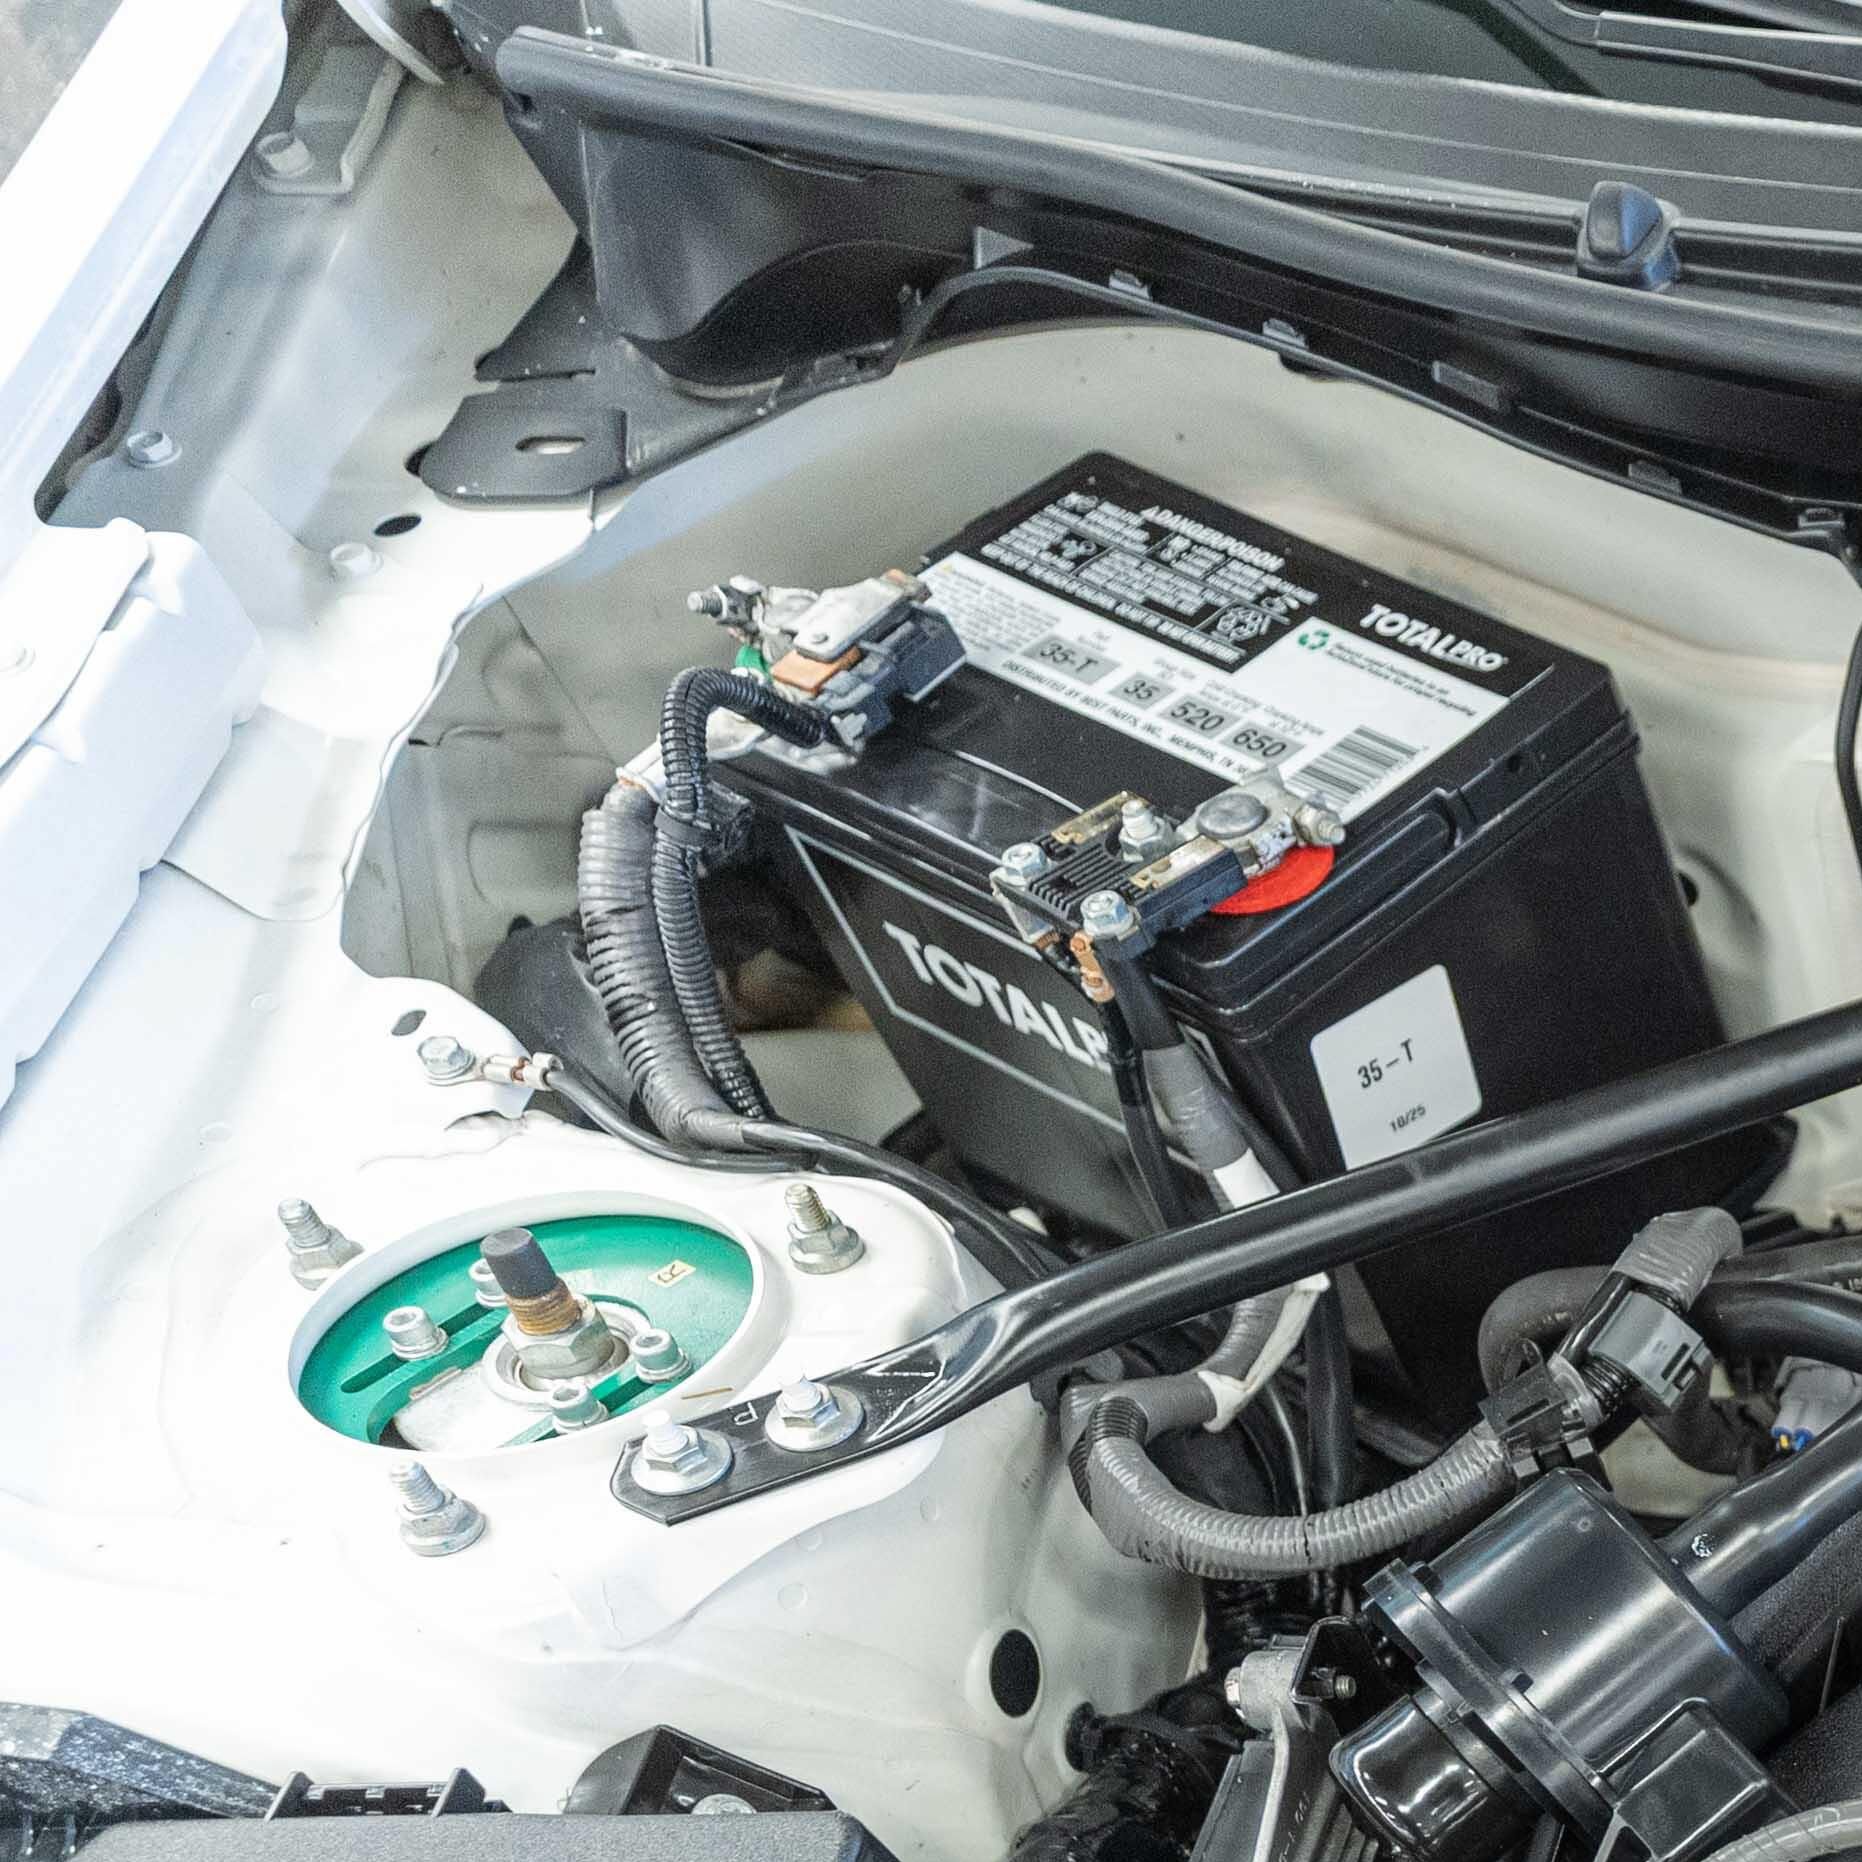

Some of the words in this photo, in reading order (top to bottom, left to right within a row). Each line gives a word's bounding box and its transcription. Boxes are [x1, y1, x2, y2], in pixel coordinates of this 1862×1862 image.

[1360, 603, 1504, 672] TOTALPRO
[1040, 643, 1100, 673] 35-T
[1123, 678, 1161, 700] 35
[1170, 701, 1225, 732] 520
[1233, 730, 1287, 759] 650
